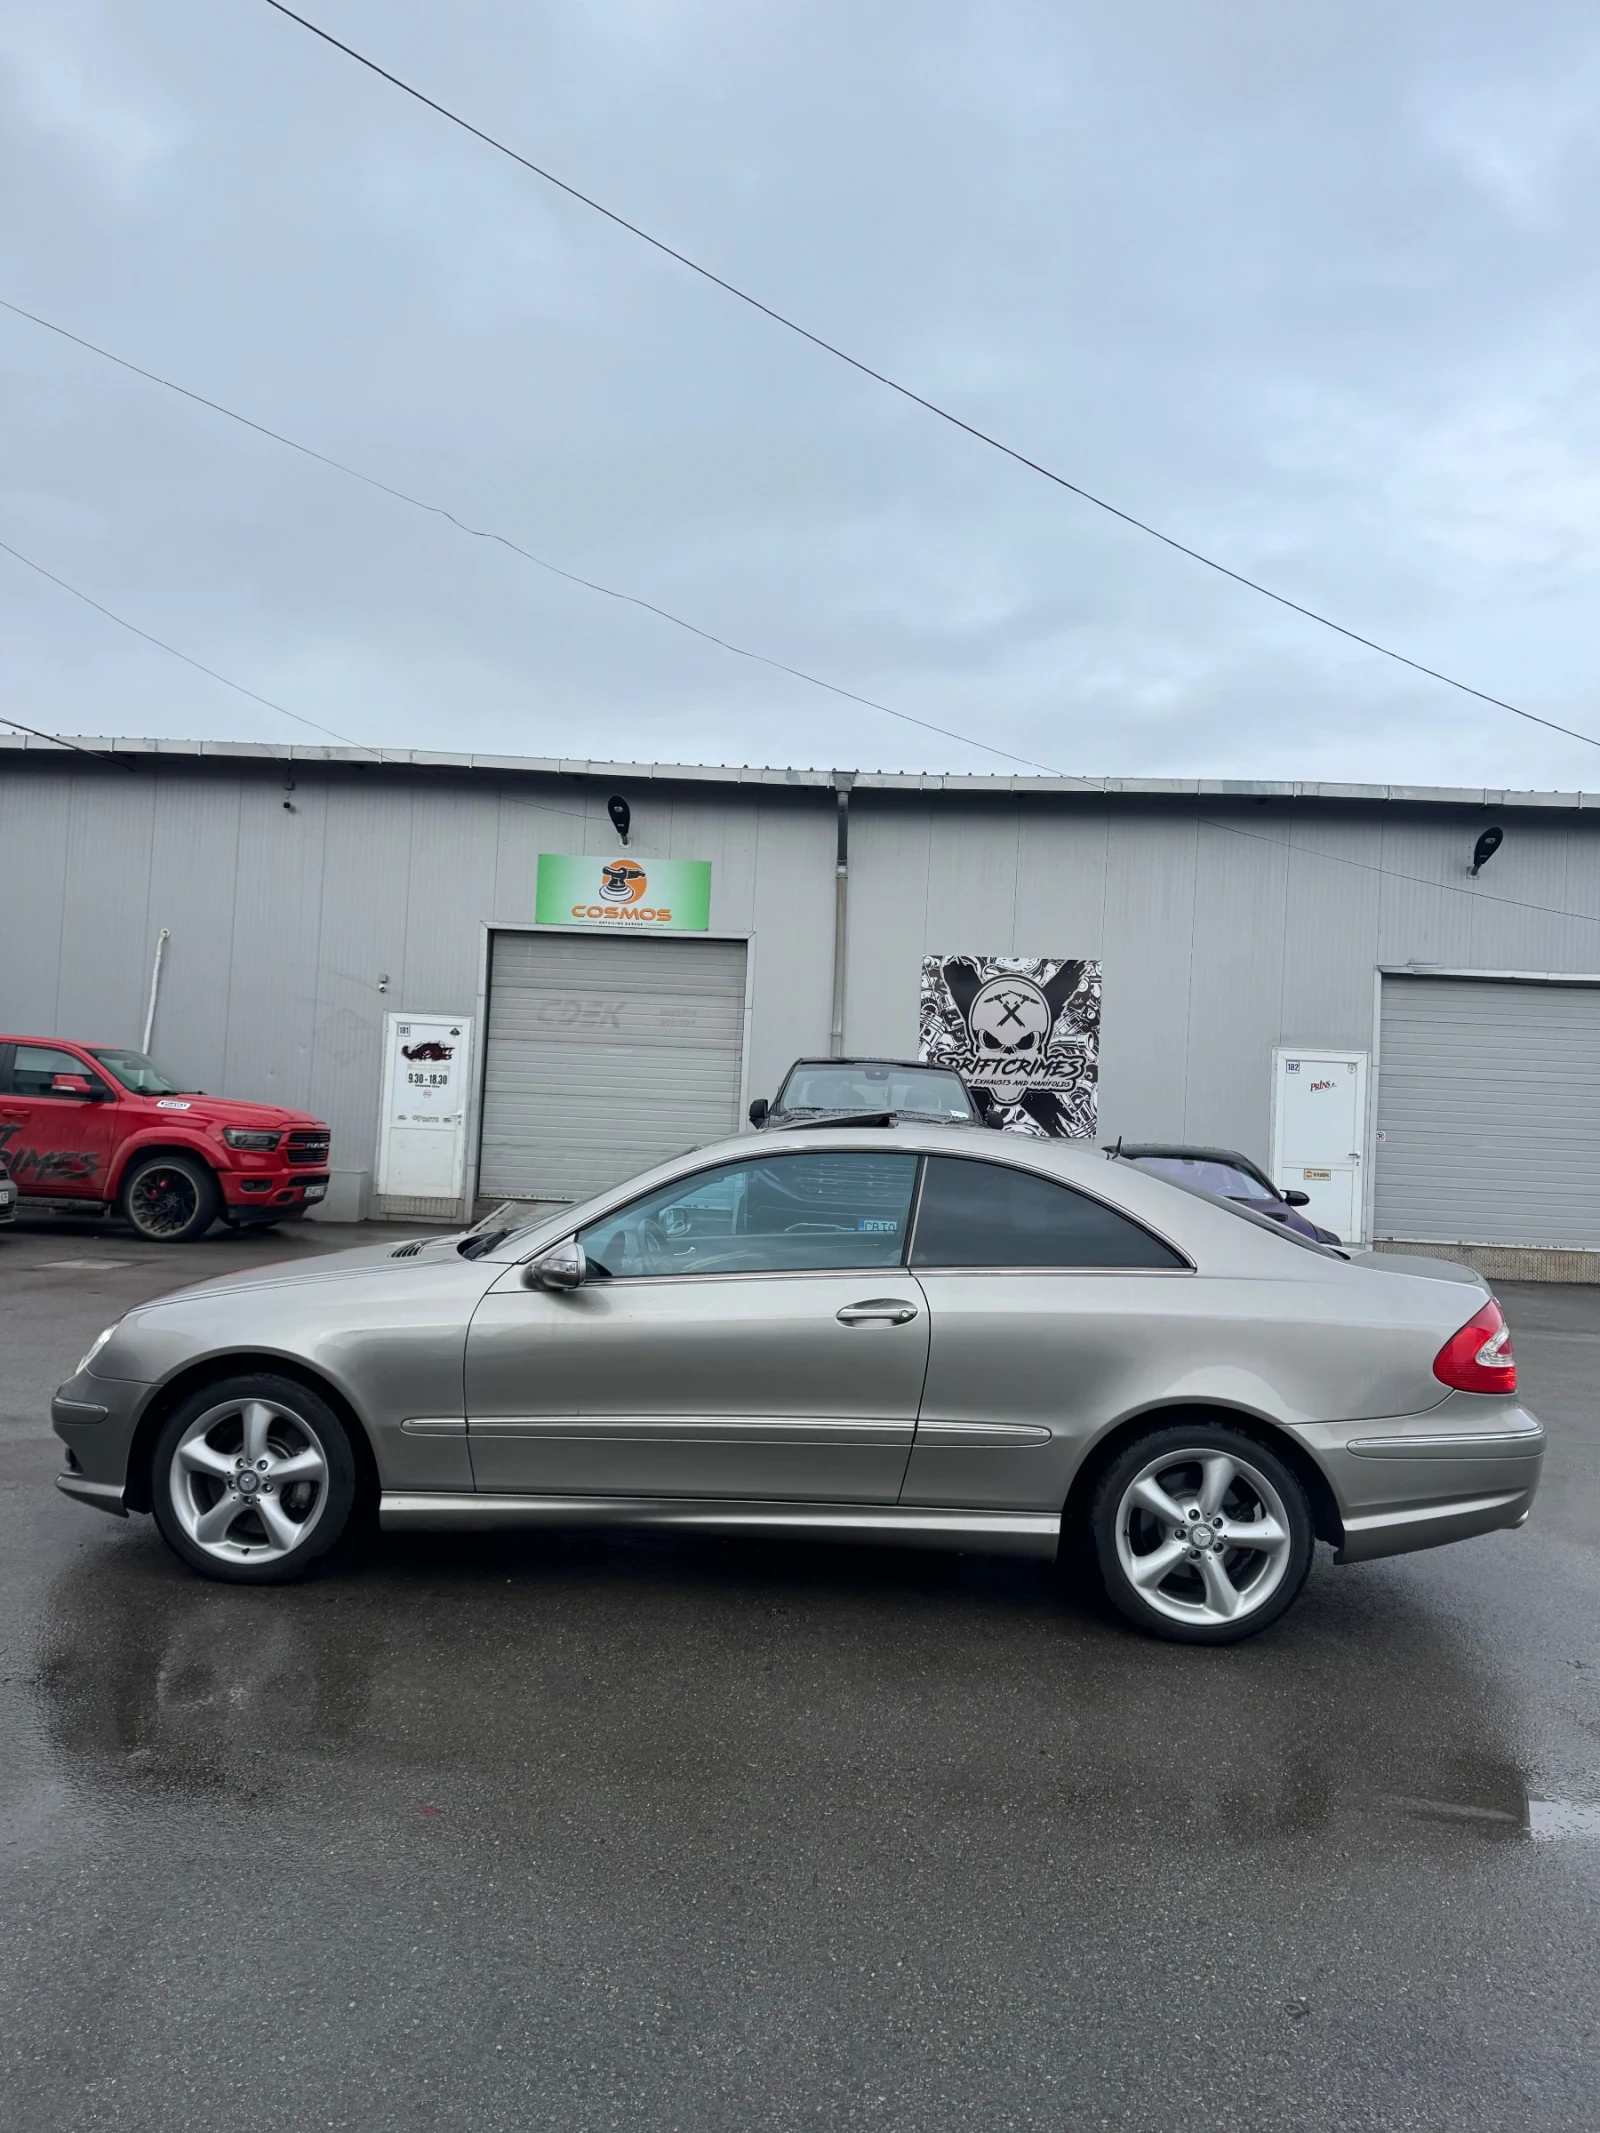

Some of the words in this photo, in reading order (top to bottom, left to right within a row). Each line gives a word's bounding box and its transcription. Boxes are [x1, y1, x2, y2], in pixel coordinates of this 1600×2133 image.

[571, 905, 672, 922] COSMOS
[1288, 1063, 1300, 1072] 182
[408, 1073, 424, 1084] 9.30
[429, 1074, 448, 1085] 18.30
[974, 1078, 1011, 1086] EXHAUSTS
